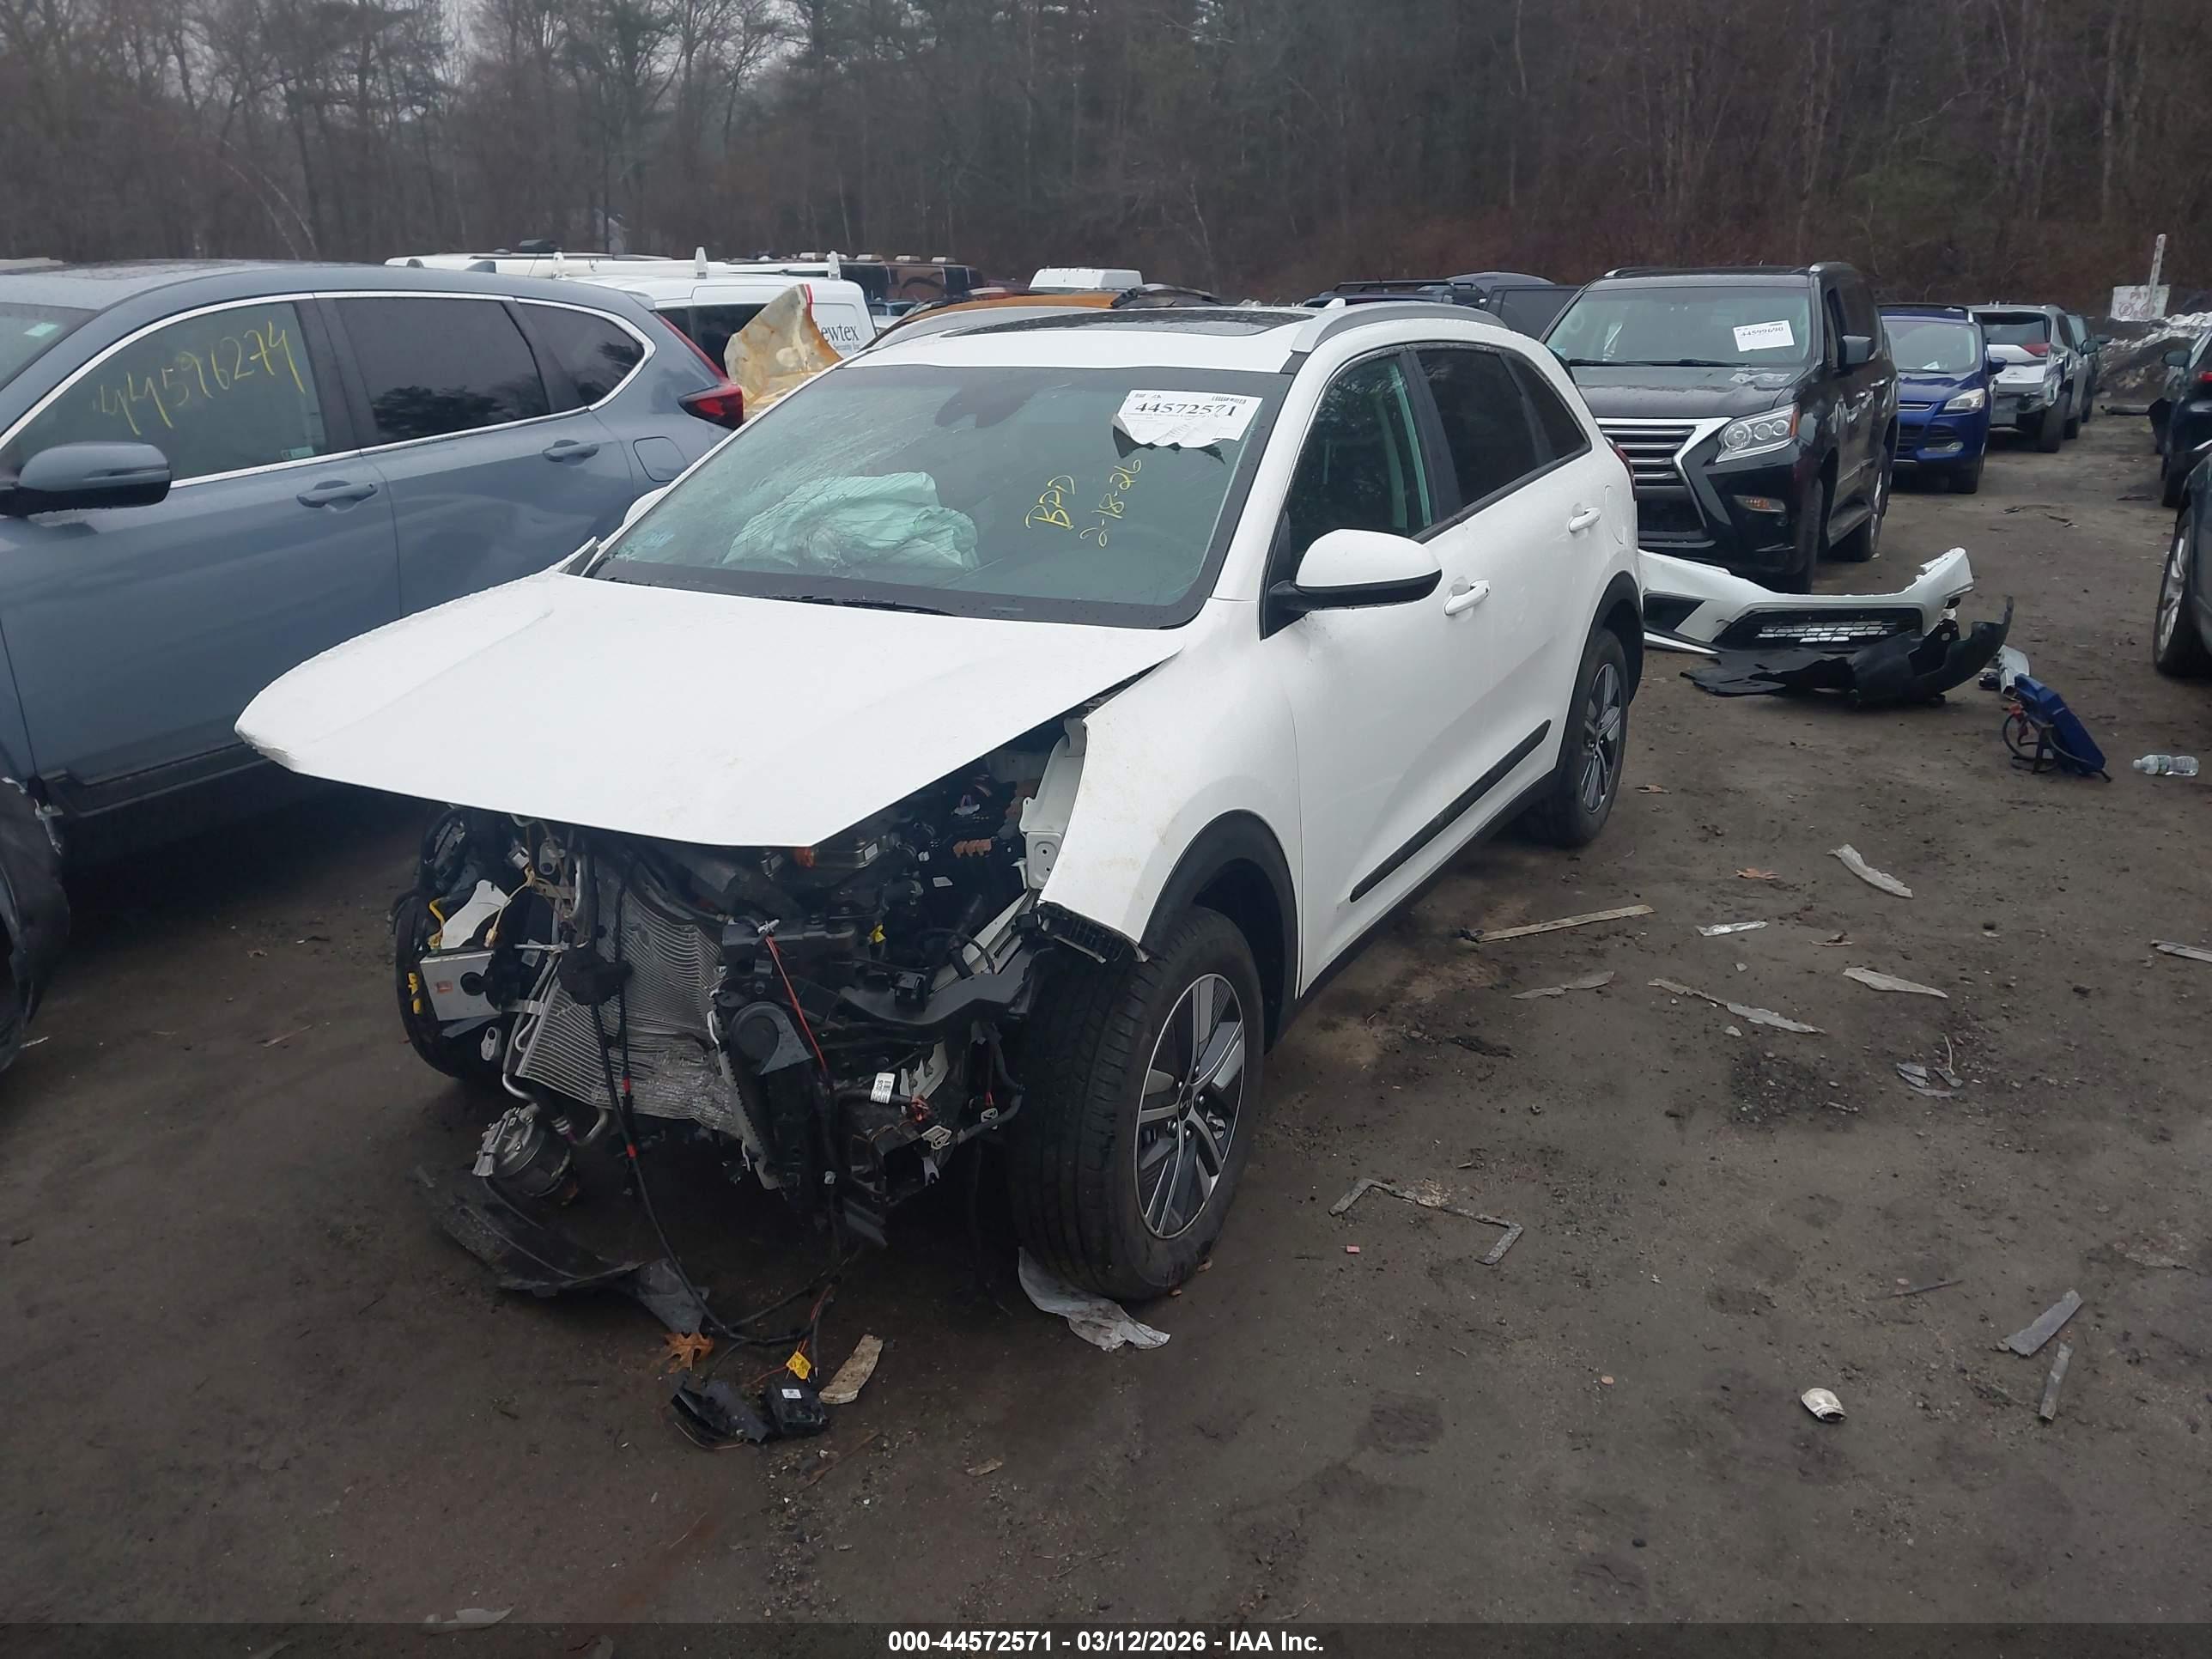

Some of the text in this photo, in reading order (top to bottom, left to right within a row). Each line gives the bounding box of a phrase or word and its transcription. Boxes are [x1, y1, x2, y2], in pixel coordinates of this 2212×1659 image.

[820, 323, 859, 342] ewtex
[100, 320, 306, 435] 44596274
[1134, 402, 1237, 417] 44572571
